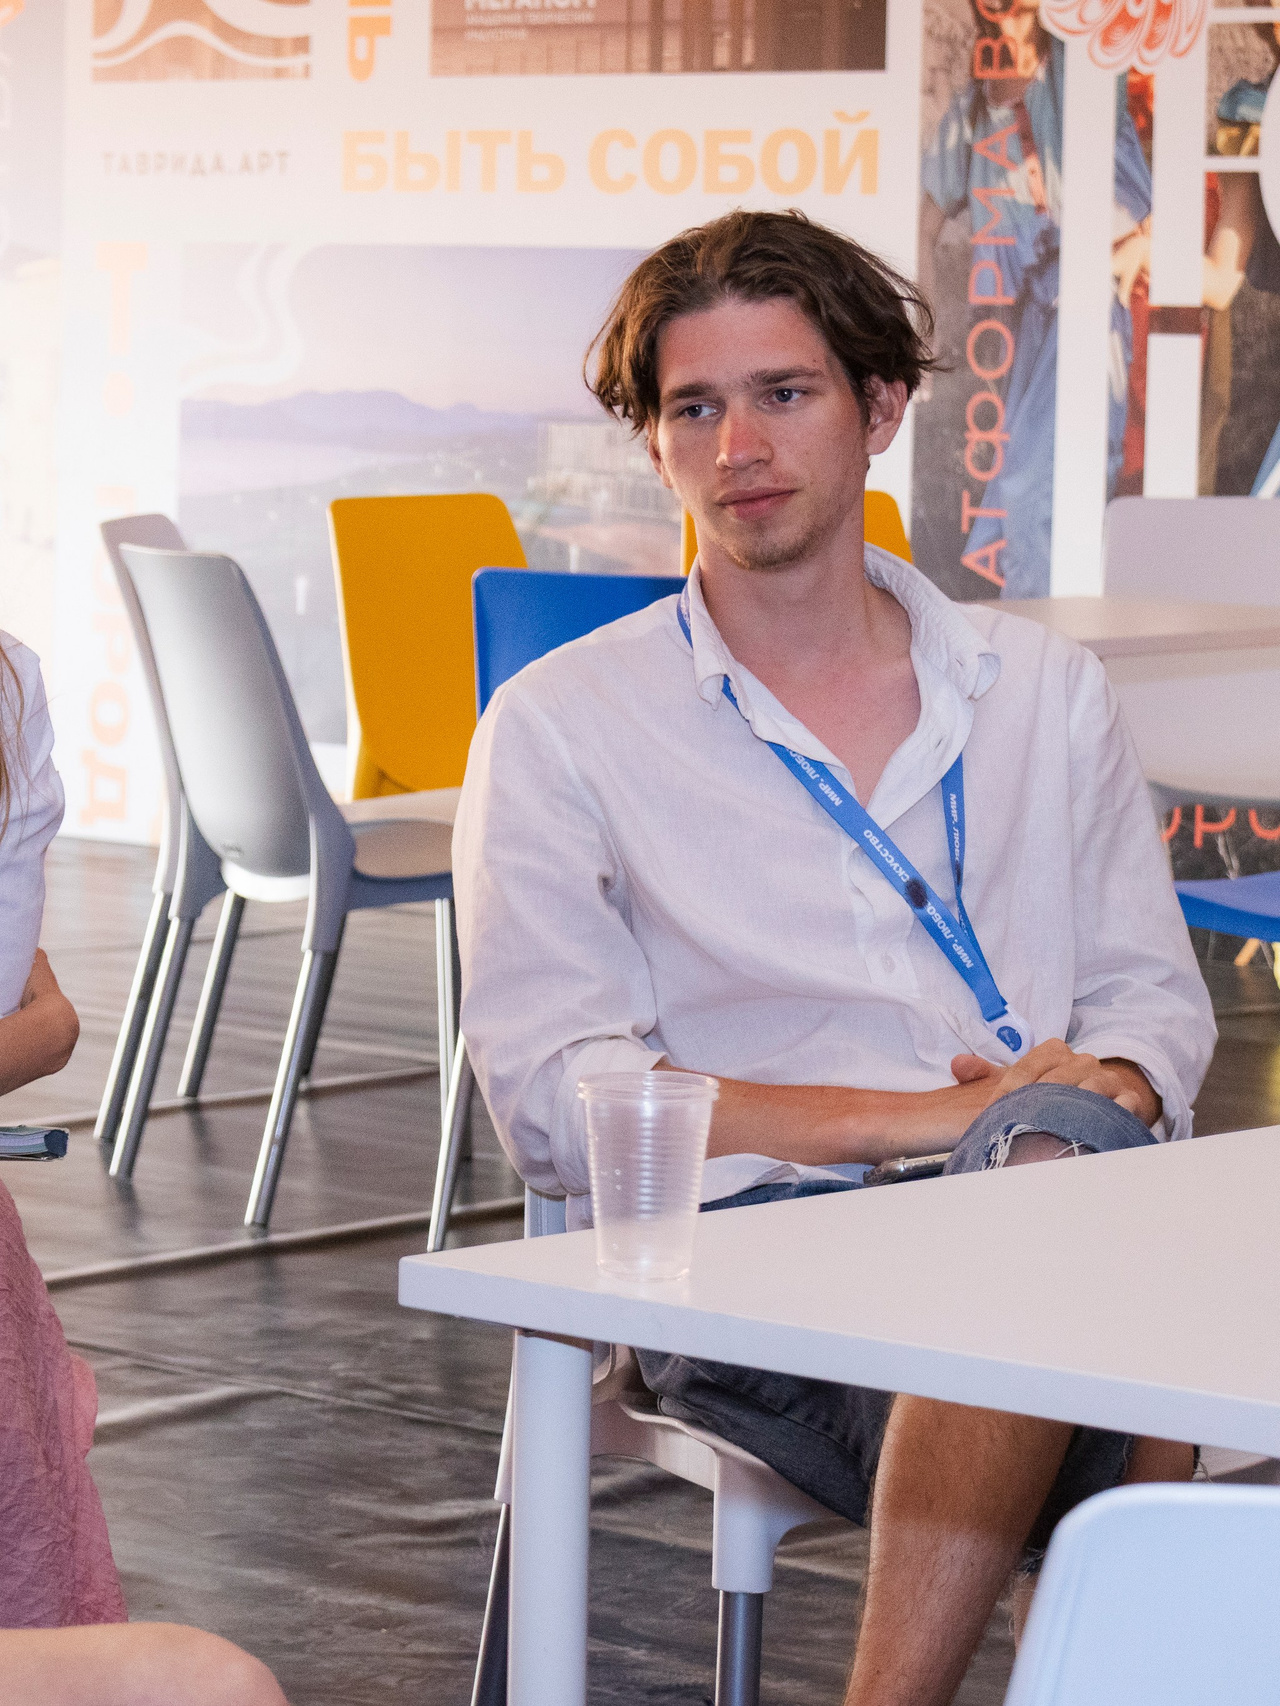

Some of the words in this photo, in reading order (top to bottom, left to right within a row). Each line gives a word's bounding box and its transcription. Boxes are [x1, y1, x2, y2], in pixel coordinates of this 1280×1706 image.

[101, 149, 291, 177] ТАВРИДА.АРТ
[341, 129, 567, 194] БЫТЬ
[587, 110, 880, 196] СОБОЙ
[863, 829, 910, 883] СКУССТВО
